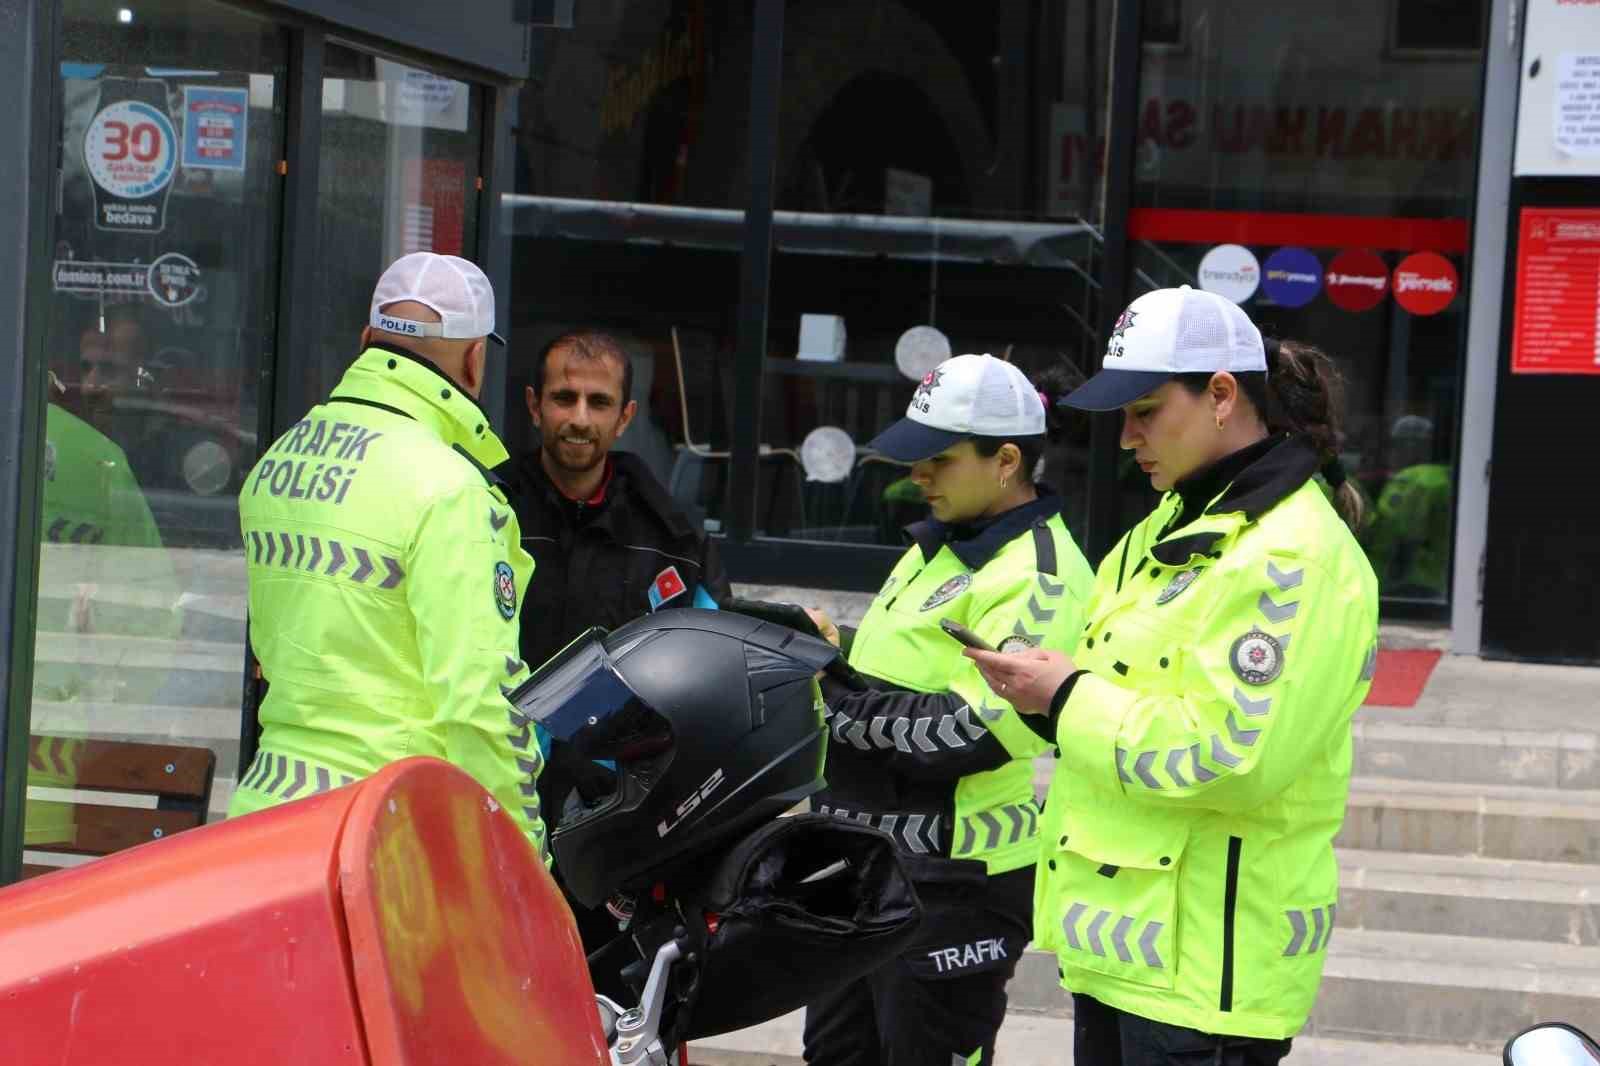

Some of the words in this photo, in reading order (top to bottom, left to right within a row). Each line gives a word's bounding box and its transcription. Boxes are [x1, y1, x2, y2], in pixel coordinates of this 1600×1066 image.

[102, 120, 162, 163] 30
[106, 209, 153, 225] bedava
[380, 318, 417, 334] POLİS
[252, 459, 357, 505] POLİSİ
[657, 767, 726, 838] LS2
